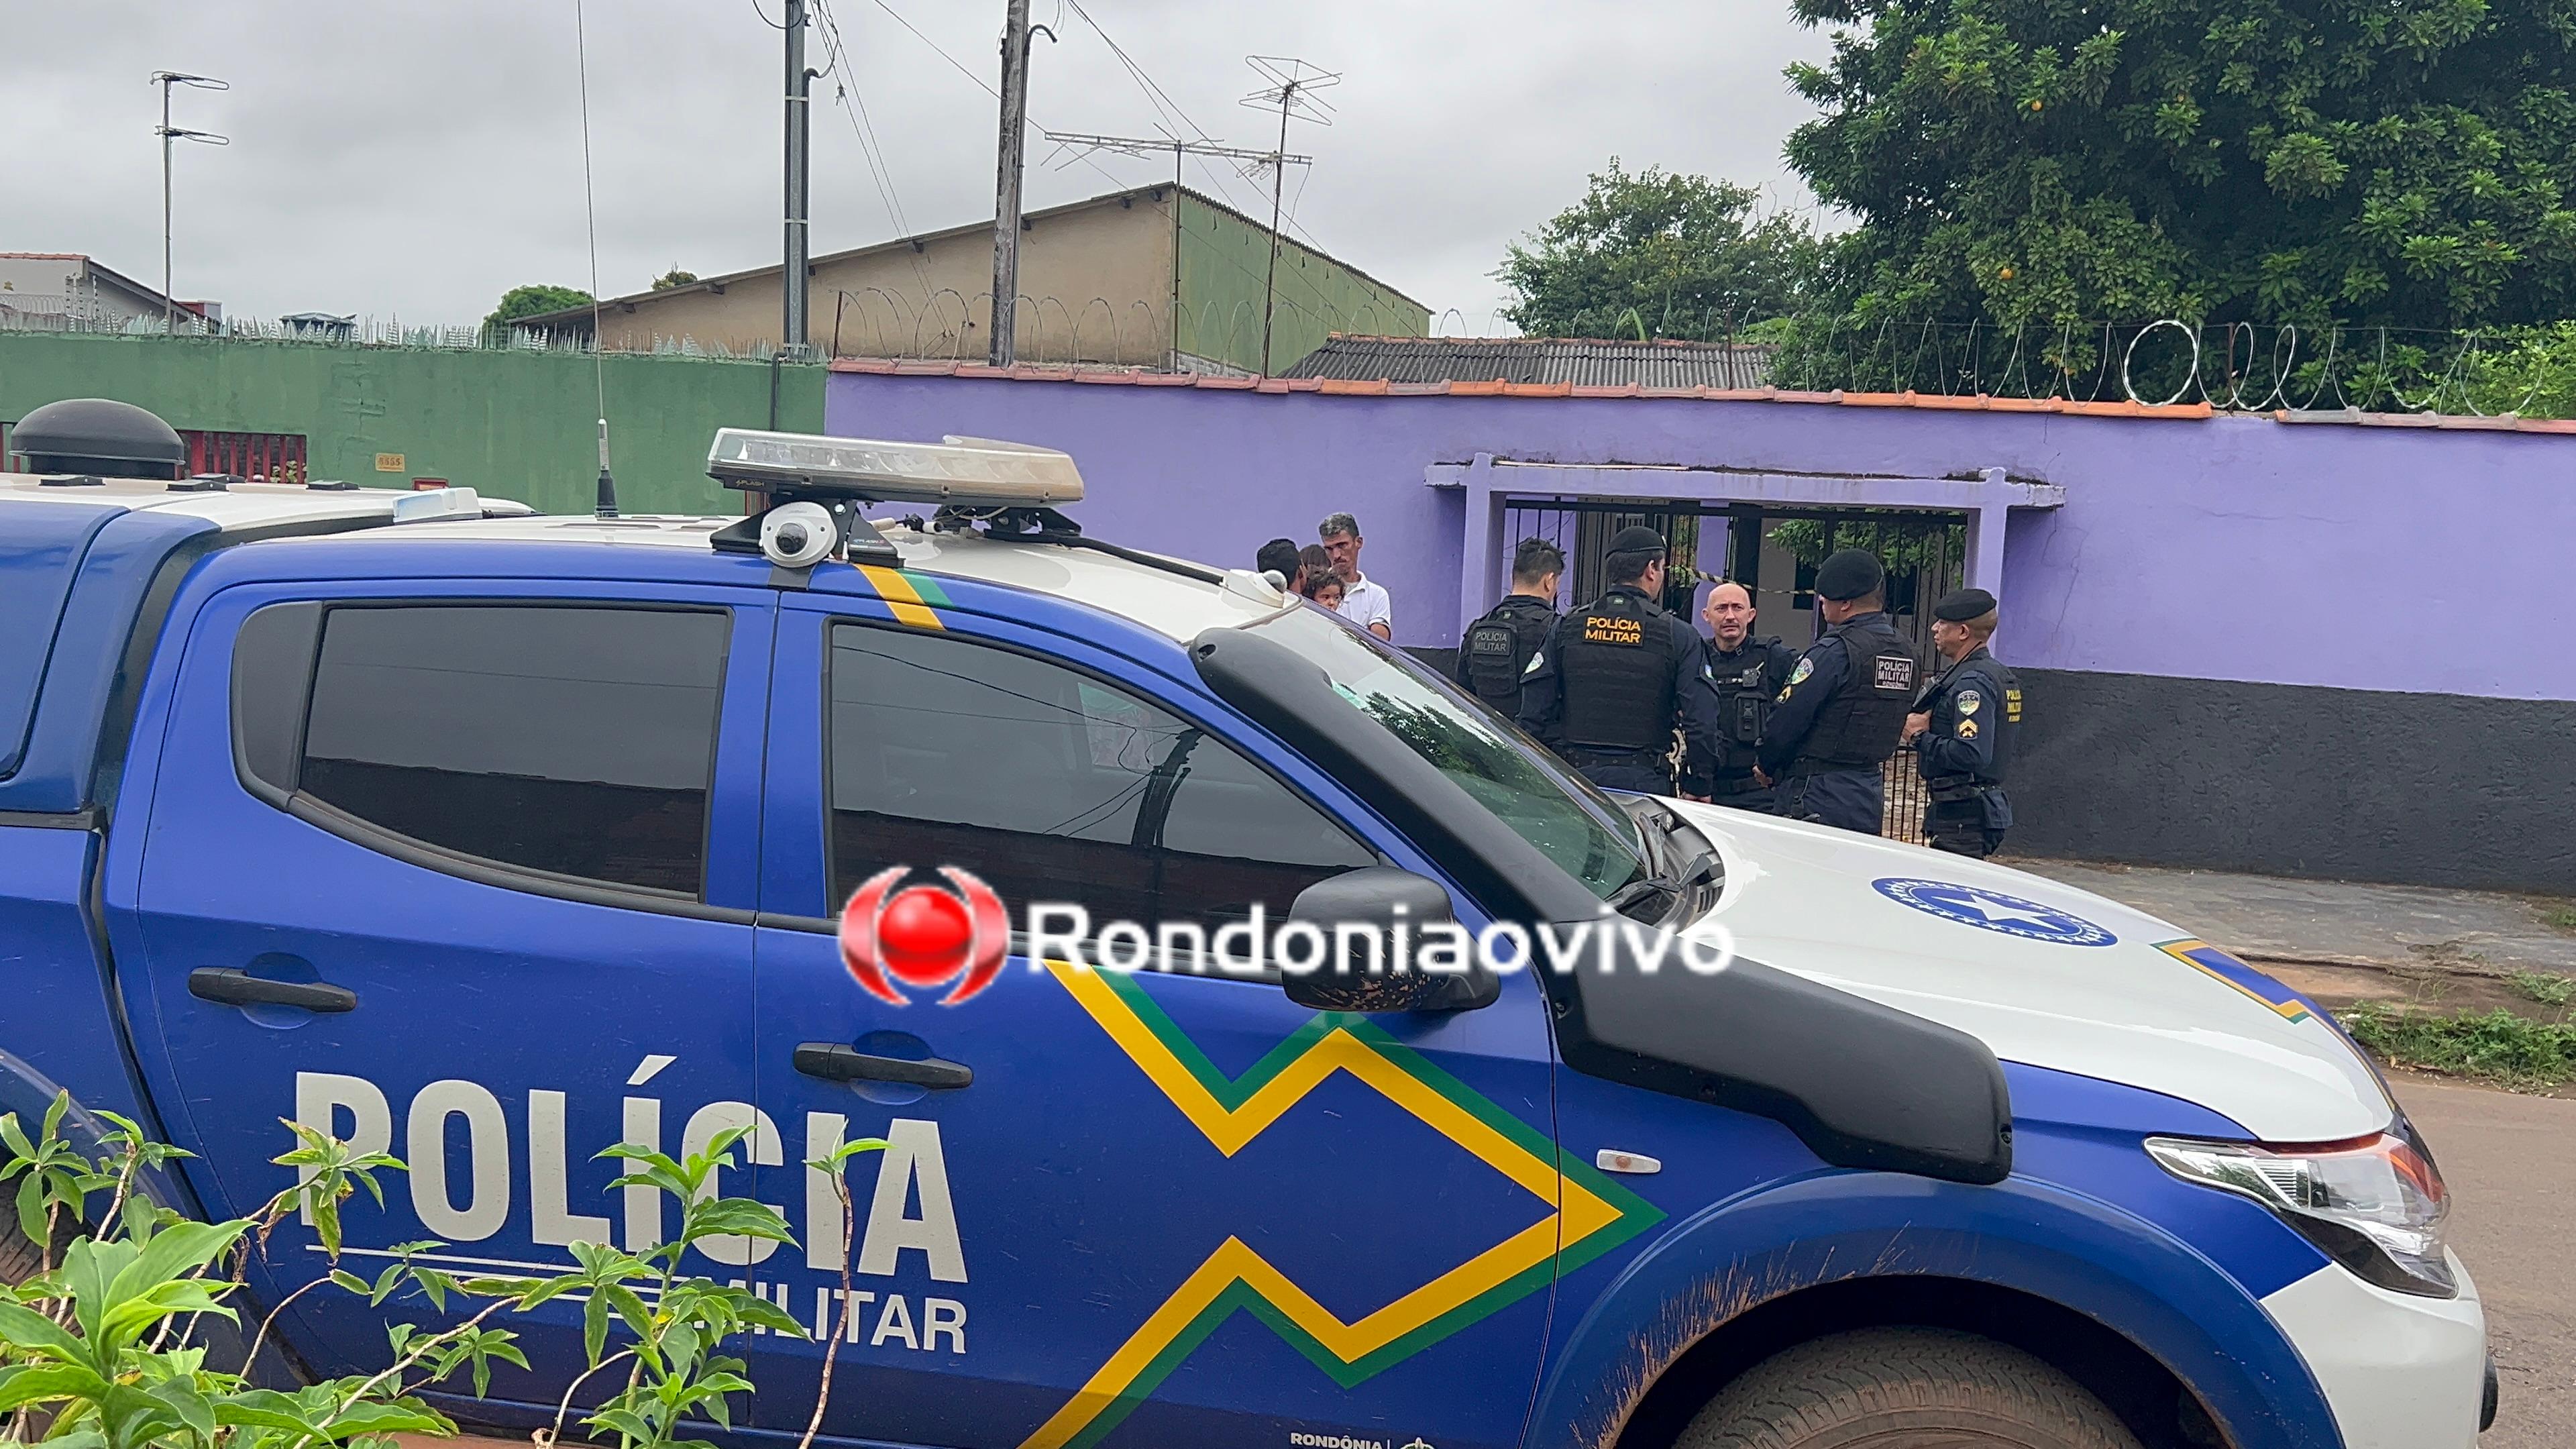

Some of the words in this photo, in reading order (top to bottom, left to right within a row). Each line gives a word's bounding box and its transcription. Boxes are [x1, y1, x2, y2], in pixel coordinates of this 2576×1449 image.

[1587, 616, 1642, 631] POLÍCIA
[1585, 629, 1642, 644] MILITAR
[1474, 642, 1506, 651] MILITAR
[1878, 670, 1910, 682] MILITAR
[296, 1055, 968, 1283] POLÍCIA
[693, 1276, 967, 1354] ILITAR
[1290, 1432, 1383, 1449] RONDÔNIA
